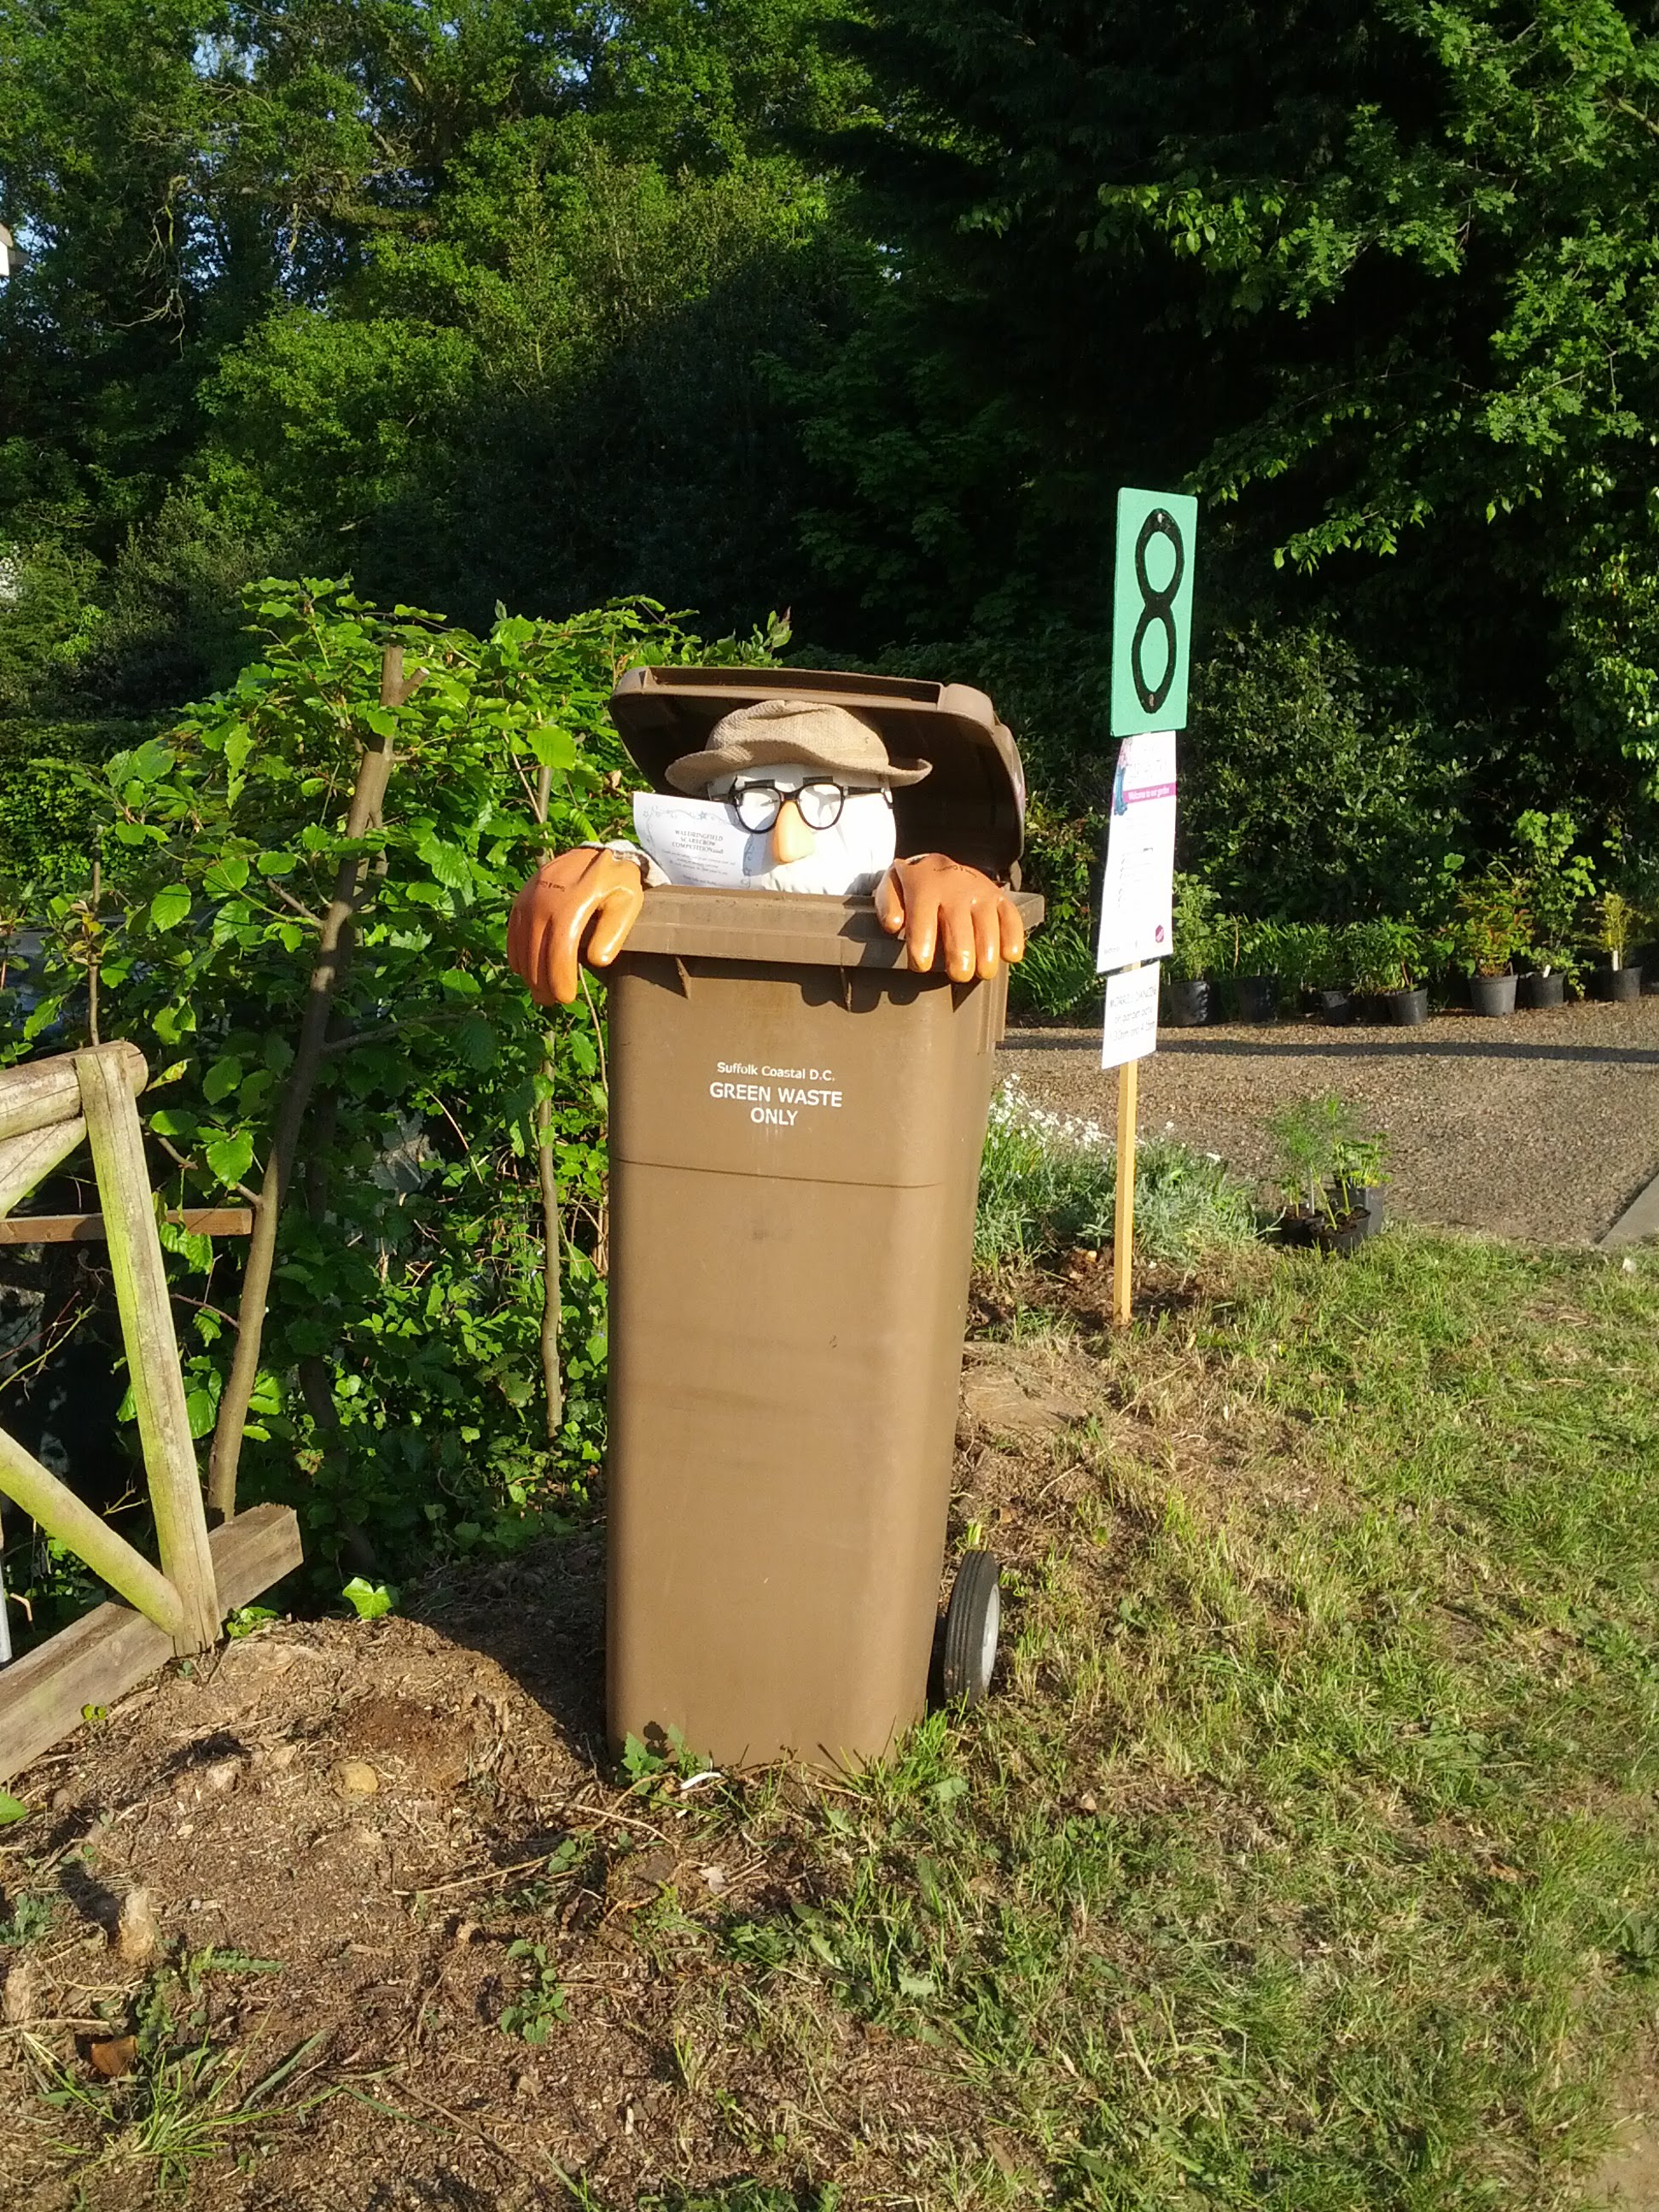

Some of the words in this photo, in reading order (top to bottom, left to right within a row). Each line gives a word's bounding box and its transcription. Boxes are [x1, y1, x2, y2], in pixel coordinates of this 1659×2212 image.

[1132, 508, 1185, 713] 8
[717, 1062, 759, 1075] Suffolk
[761, 1065, 806, 1080] Coastal
[809, 1068, 835, 1081] D.C.
[710, 1081, 771, 1103] GREEN
[777, 1086, 843, 1108] WASTE
[750, 1107, 799, 1126] ONLY
